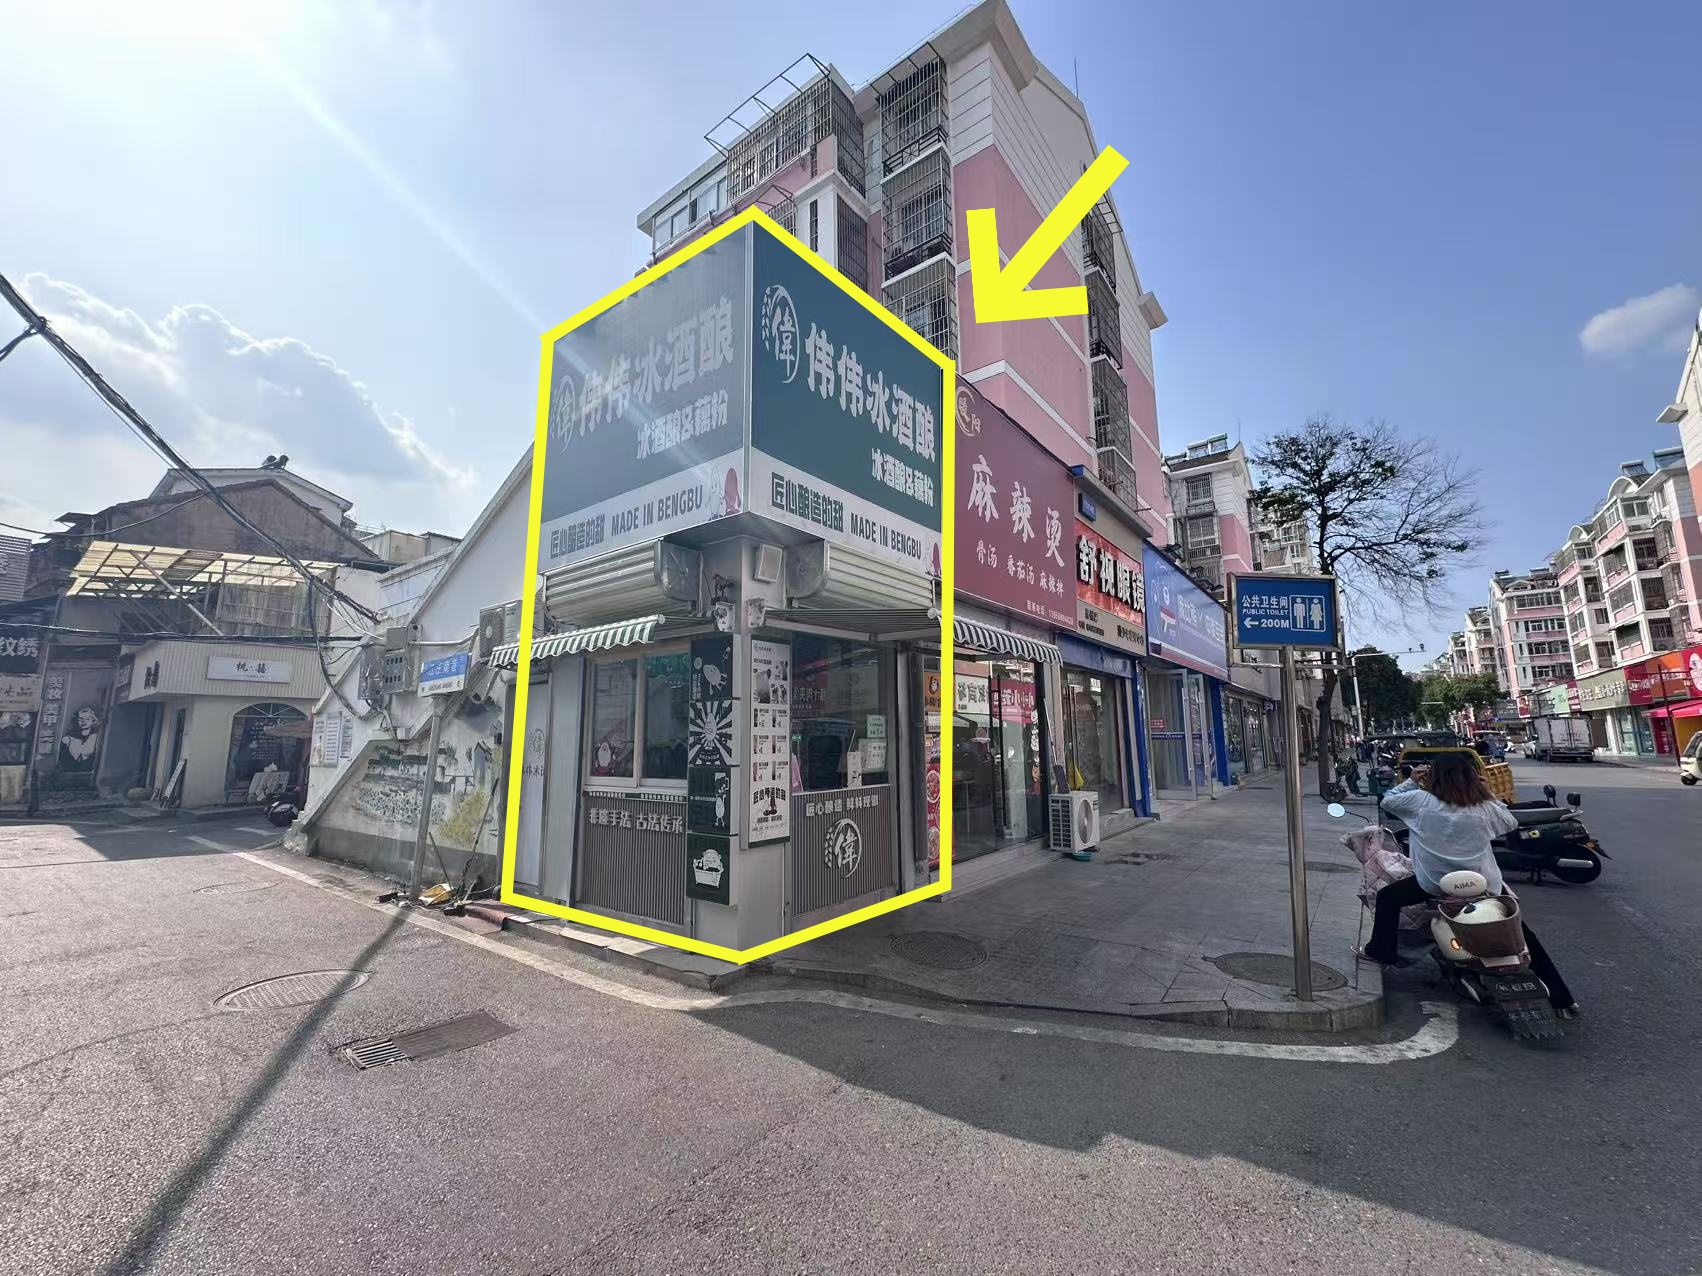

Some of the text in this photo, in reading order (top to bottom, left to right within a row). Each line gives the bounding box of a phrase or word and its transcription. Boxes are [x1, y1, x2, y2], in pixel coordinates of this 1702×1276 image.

[580, 296, 735, 437] 伟伟冰酒酿
[805, 322, 936, 463] 伟伟冰酒酿
[551, 485, 704, 559] 匠心酿造的甜 MADE IN BENGBU
[771, 471, 922, 560] 匠心酿造的甜 MADE IN BENGBU
[967, 454, 1065, 567] 麻辣烫
[976, 540, 998, 569] 骨汤
[1007, 553, 1035, 585] 番茄汤
[1080, 534, 1146, 614] 舒视眼镜
[1242, 595, 1289, 609] 公共卫生间
[1242, 608, 1289, 617] PUBLIC TOILET
[1260, 619, 1290, 629] 200M
[636, 812, 684, 834] 古法传承
[1453, 880, 1477, 890] AIMA
